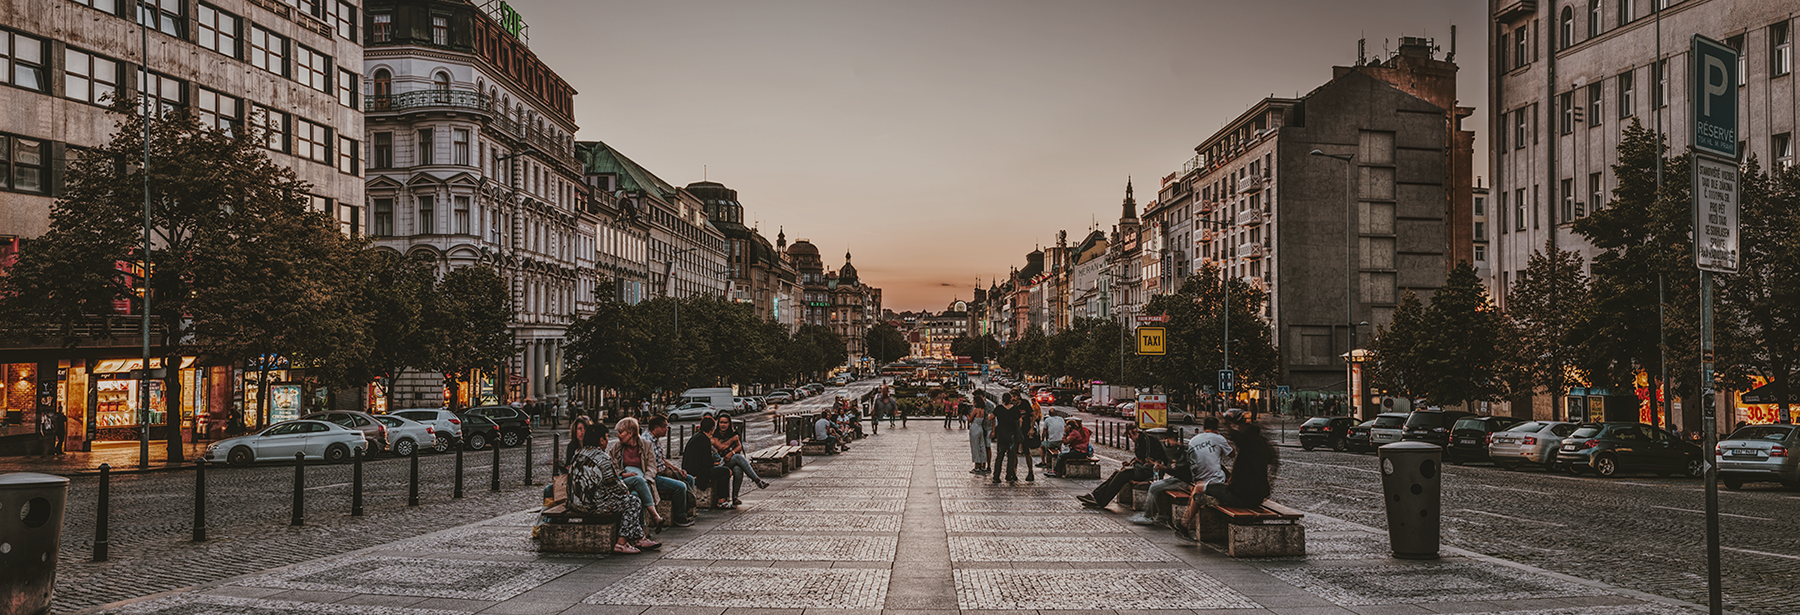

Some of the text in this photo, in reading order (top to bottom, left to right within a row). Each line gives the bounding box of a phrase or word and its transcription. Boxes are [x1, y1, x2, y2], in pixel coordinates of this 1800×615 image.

[501, 1, 522, 39] SZIF
[1704, 53, 1729, 117] P
[1205, 128, 1243, 161] HOTEL
[1698, 121, 1734, 143] RÉSERVÉ
[1078, 263, 1099, 277] MERAN
[1143, 335, 1160, 346] TAXI
